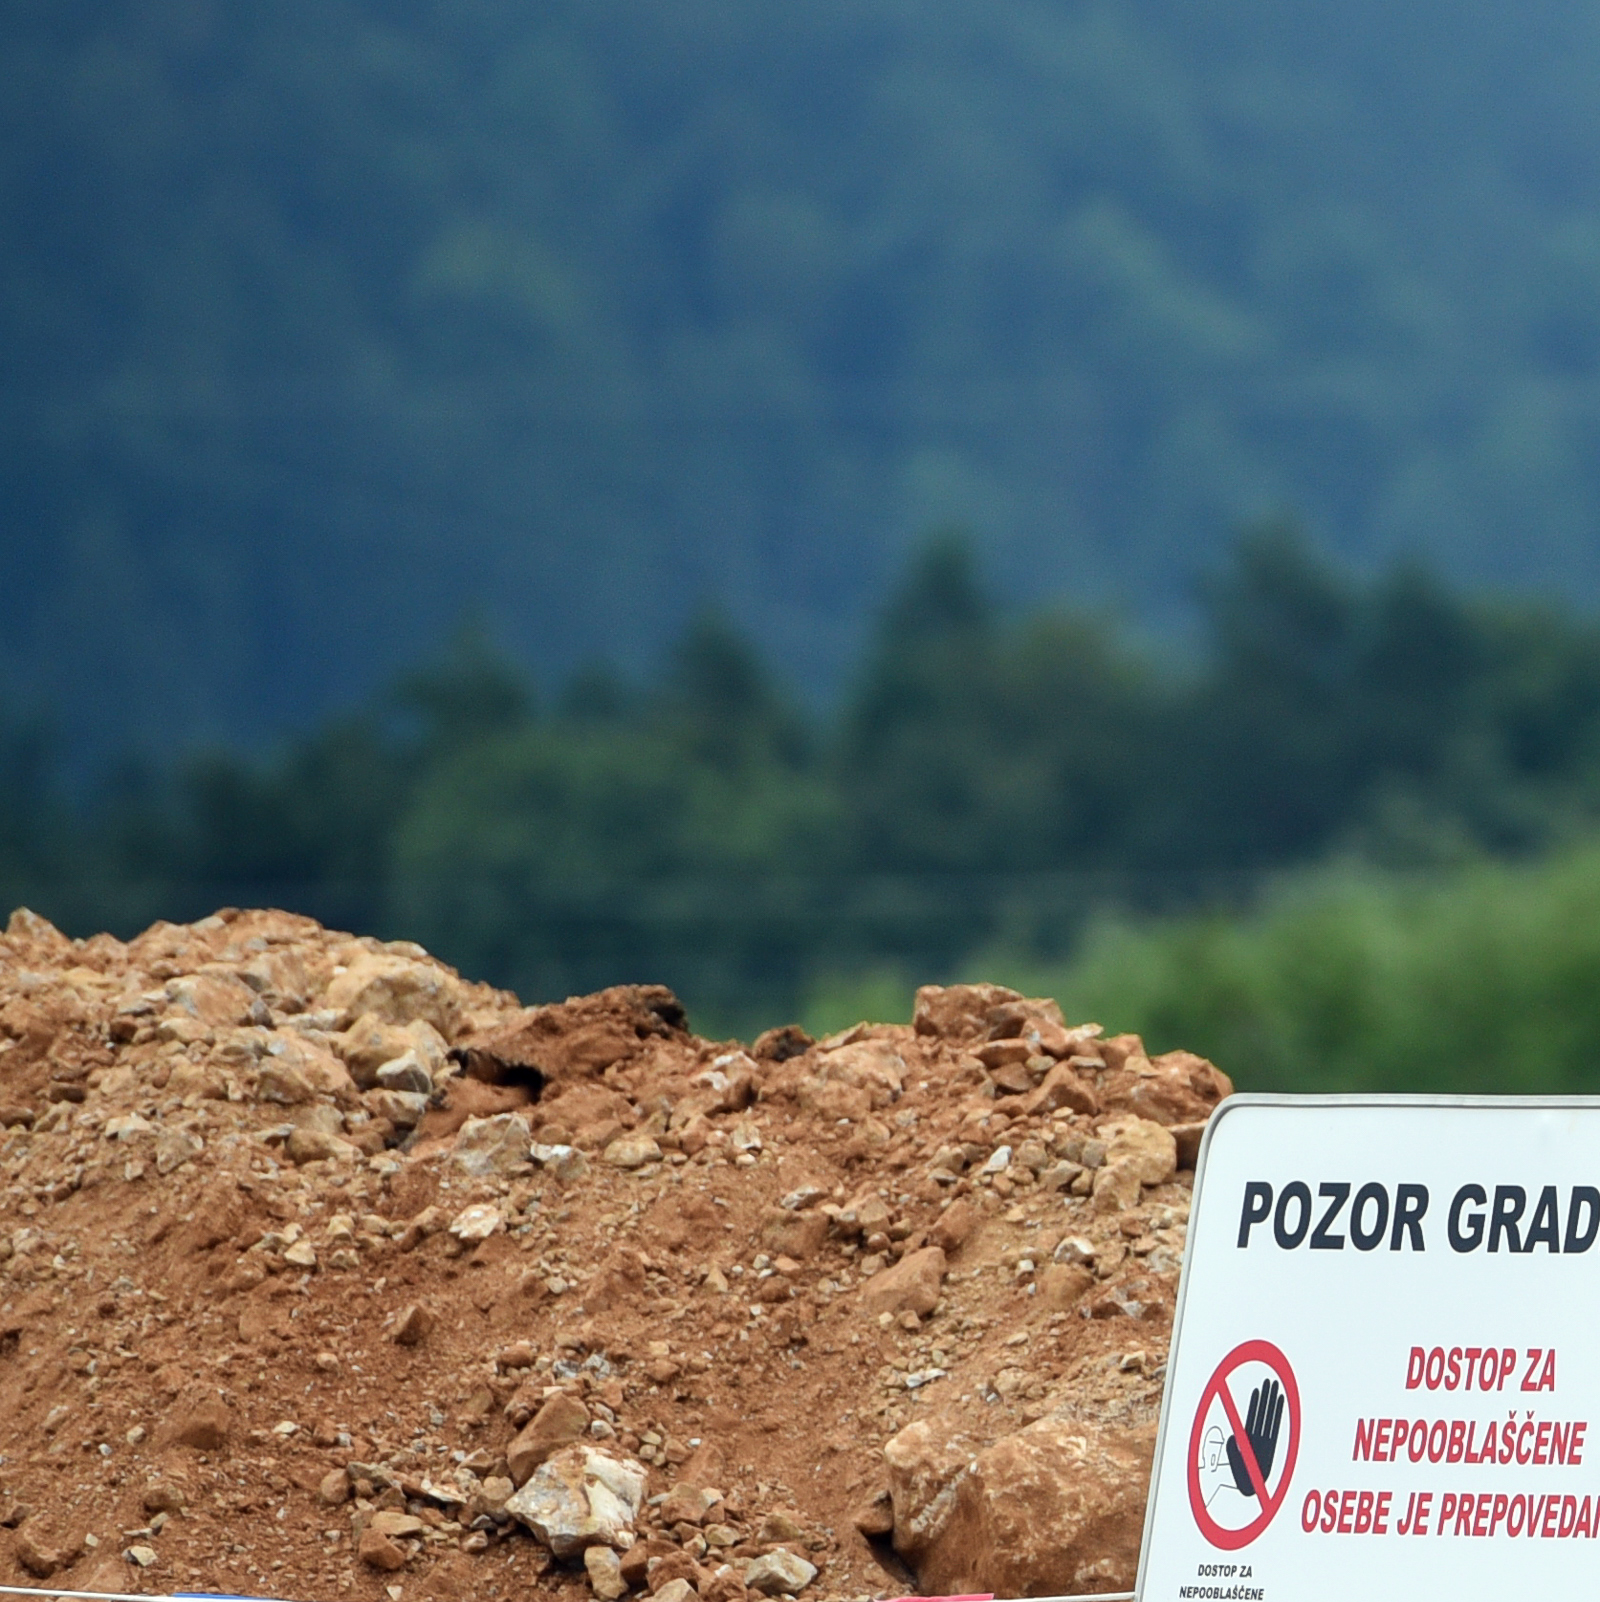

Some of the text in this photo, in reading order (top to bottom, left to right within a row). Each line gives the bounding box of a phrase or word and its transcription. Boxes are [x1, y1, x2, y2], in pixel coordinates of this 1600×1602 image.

[1237, 1181, 1429, 1251] POZOR
[1406, 1347, 1555, 1391] DOSTOP ZA
[1353, 1411, 1587, 1465] NEPOOBLAŠČENE
[1302, 1490, 1392, 1534] OSEBE
[1397, 1493, 1433, 1535] JE
[1179, 1585, 1264, 1600] NEPOOBLAŠČENE
[1198, 1564, 1252, 1577] DOSTOP ZA
